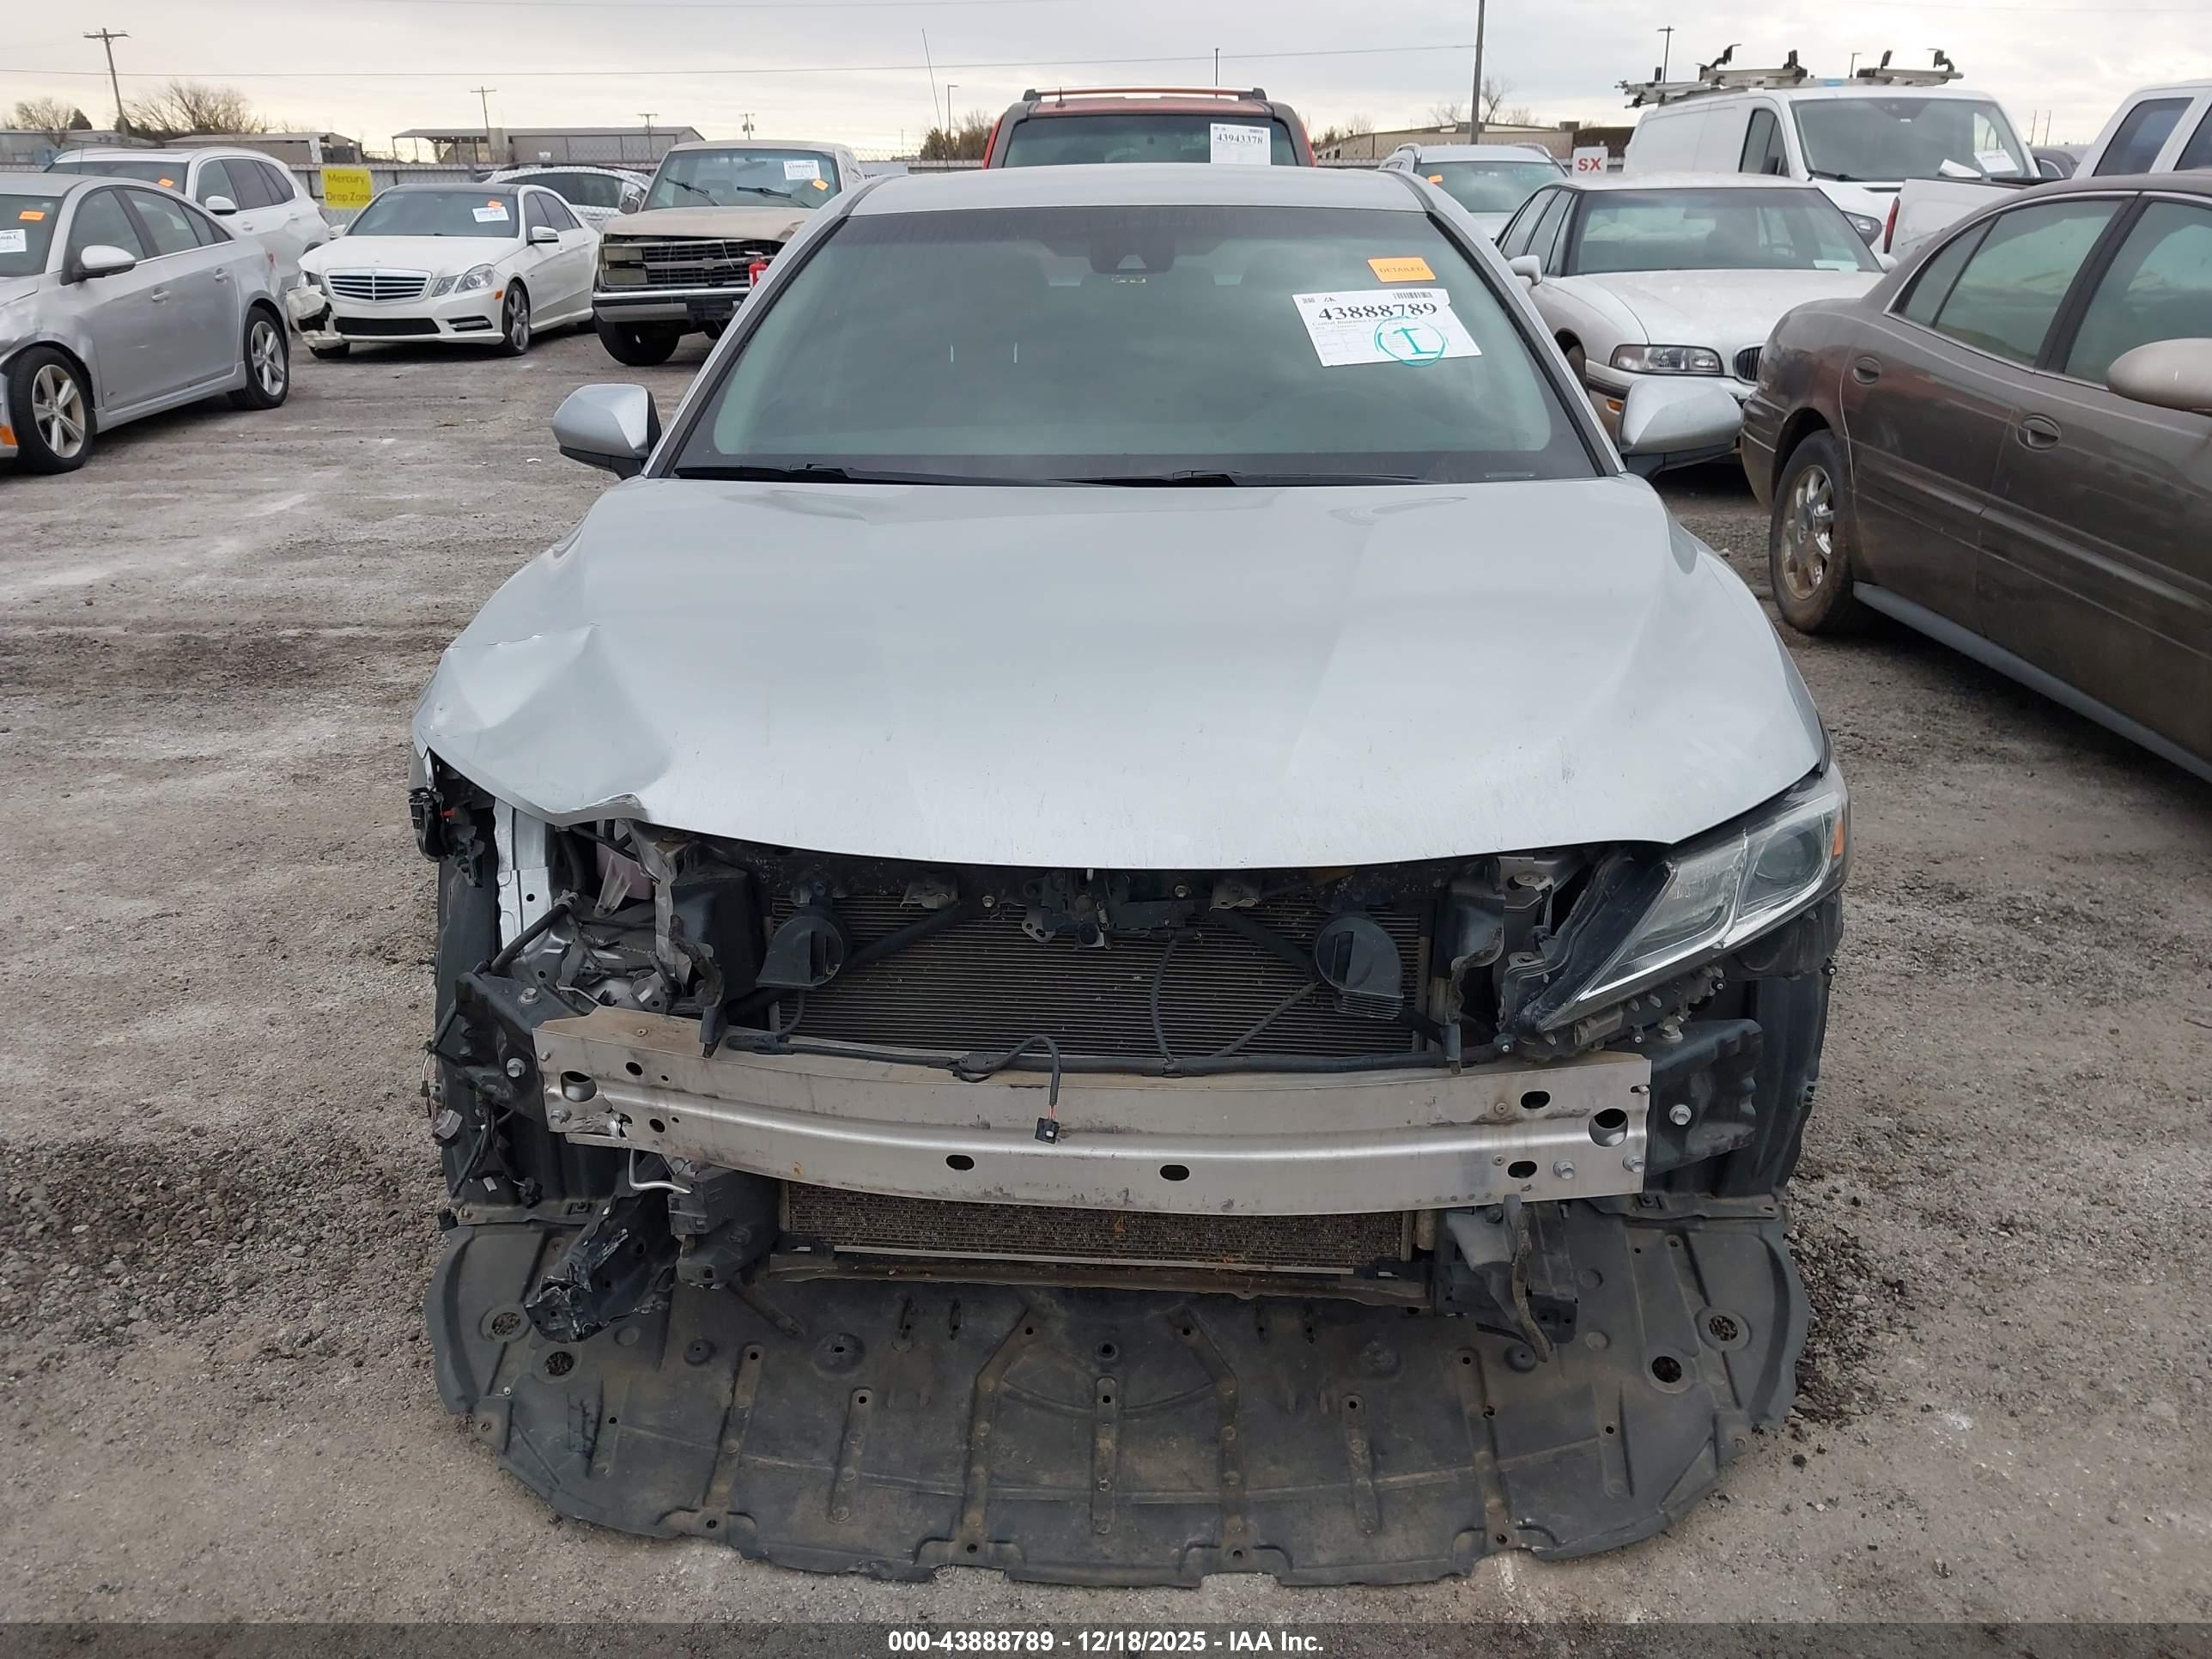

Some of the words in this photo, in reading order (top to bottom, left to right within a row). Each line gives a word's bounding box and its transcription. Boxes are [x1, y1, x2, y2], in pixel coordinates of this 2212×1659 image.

[1577, 157, 1601, 172] SX
[327, 173, 365, 185] Mercury
[325, 191, 349, 204] Drop
[1318, 301, 1437, 320] 43888789
